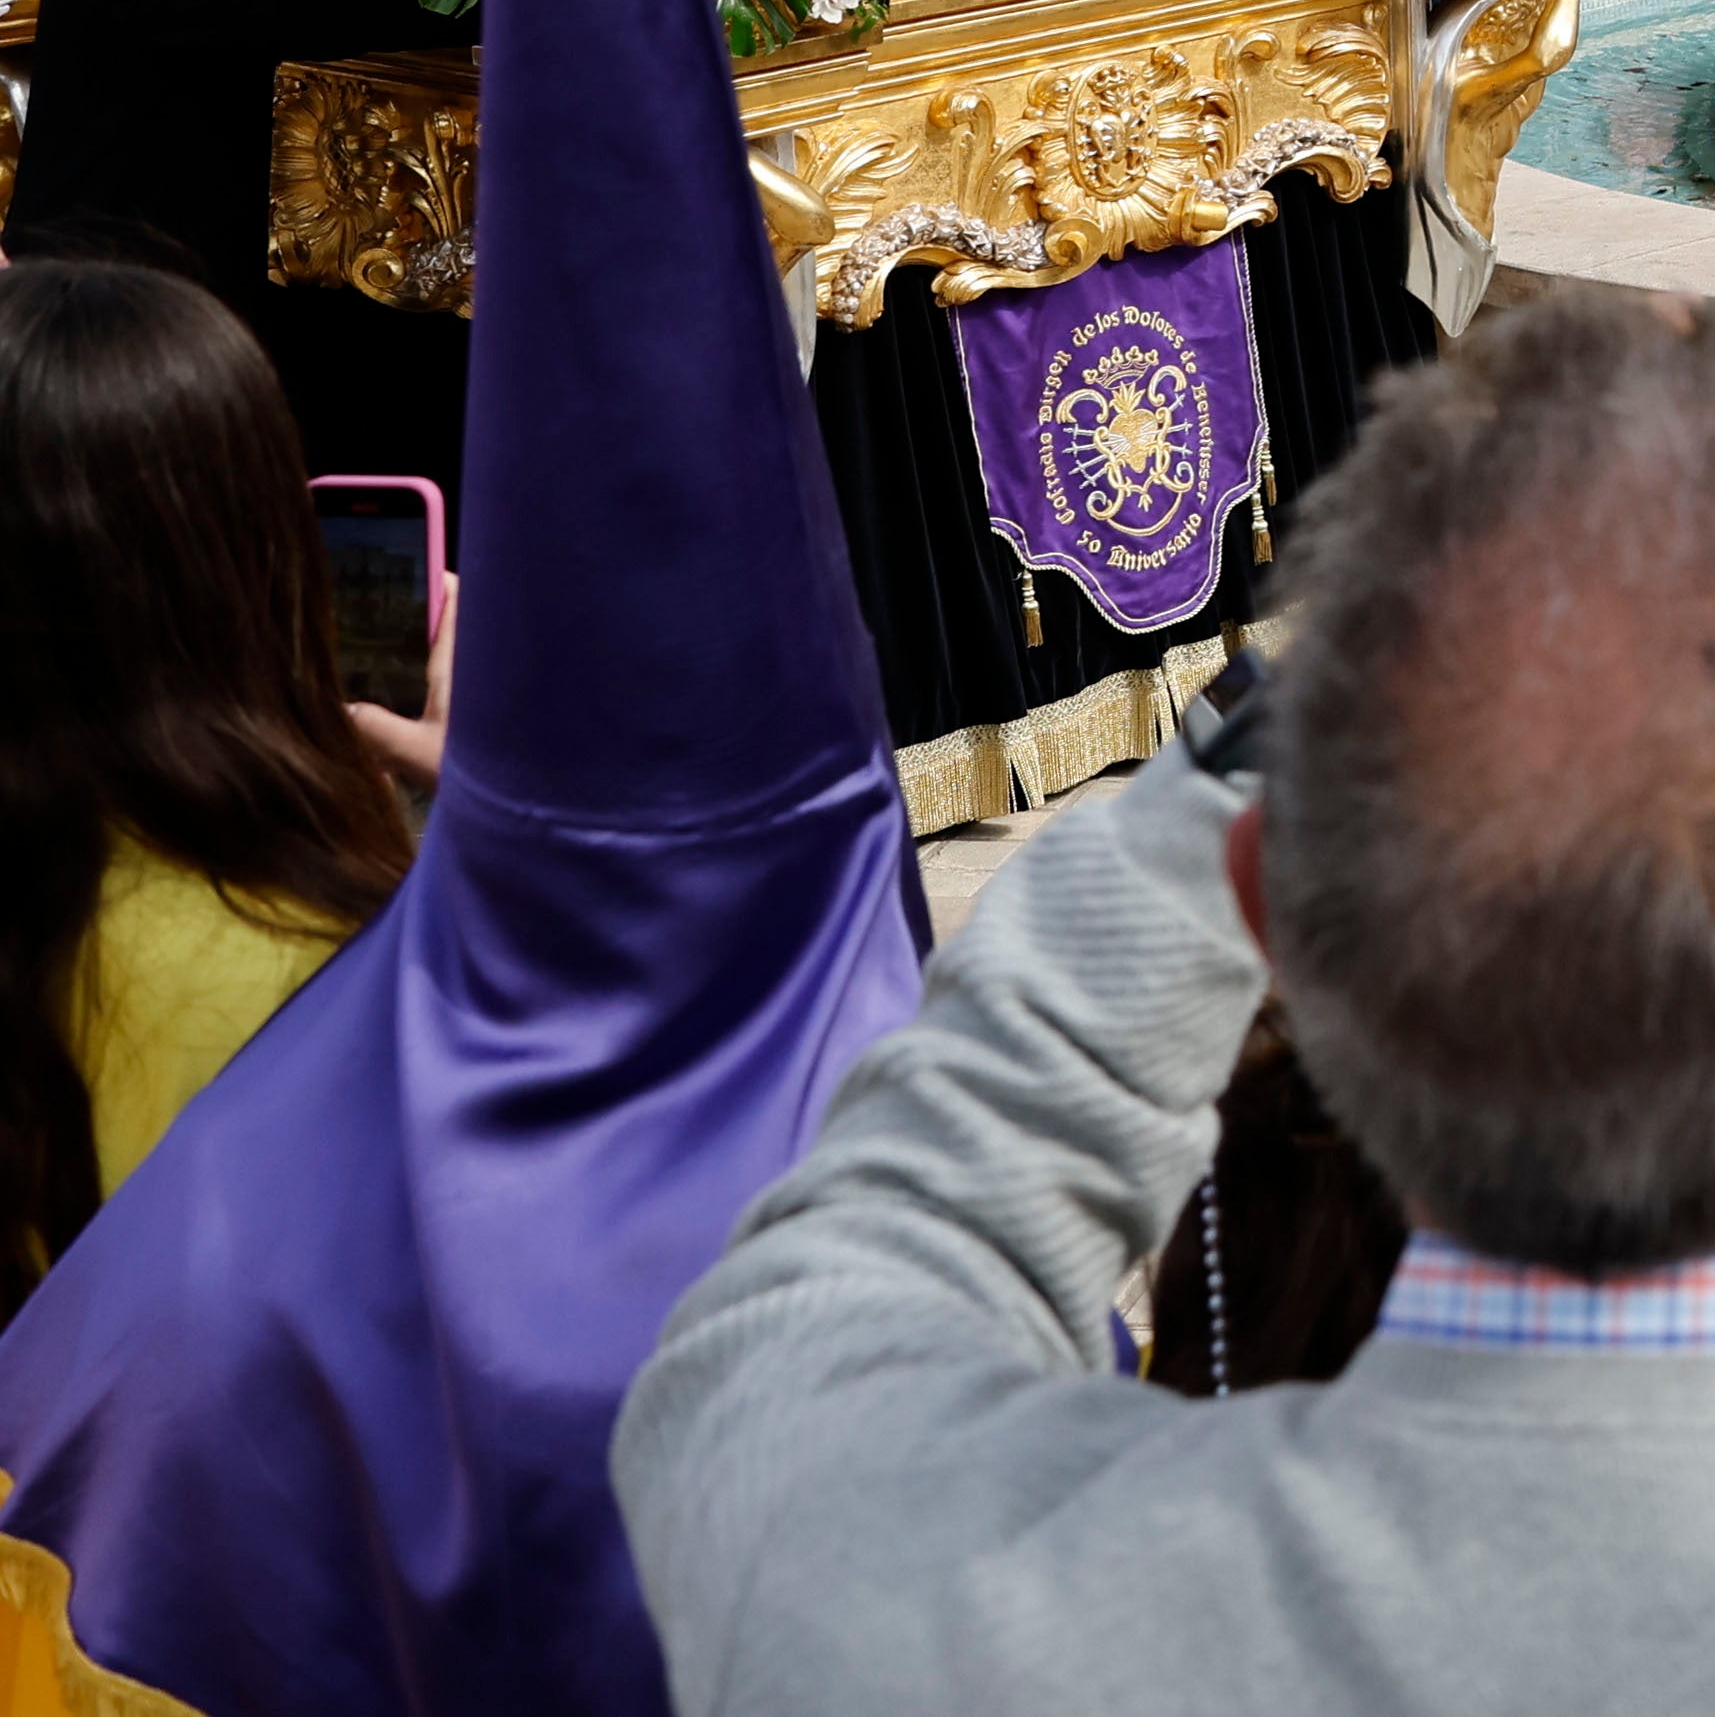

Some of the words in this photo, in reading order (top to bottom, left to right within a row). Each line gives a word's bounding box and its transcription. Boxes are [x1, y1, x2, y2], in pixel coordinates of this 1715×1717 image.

[1122, 304, 1184, 349] Dolores
[1180, 351, 1197, 374] de
[1076, 530, 1101, 554] 50
[1106, 513, 1203, 572] Aniversario
